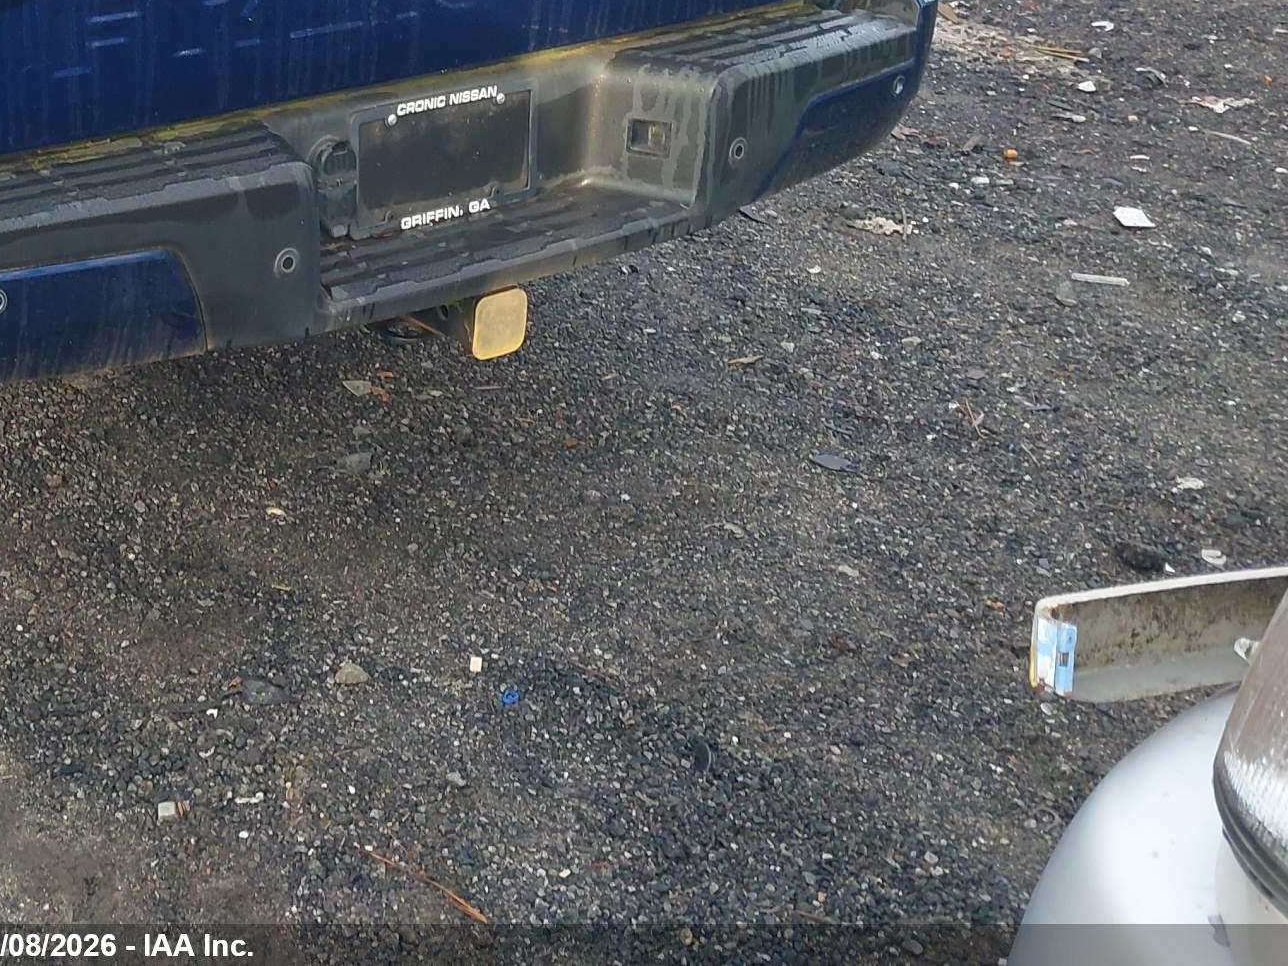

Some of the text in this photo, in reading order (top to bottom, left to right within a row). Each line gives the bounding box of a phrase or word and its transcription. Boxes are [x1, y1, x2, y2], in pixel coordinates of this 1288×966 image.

[396, 85, 498, 116] CRONIC NISSAN
[400, 198, 491, 230] GRIFFIN, GA
